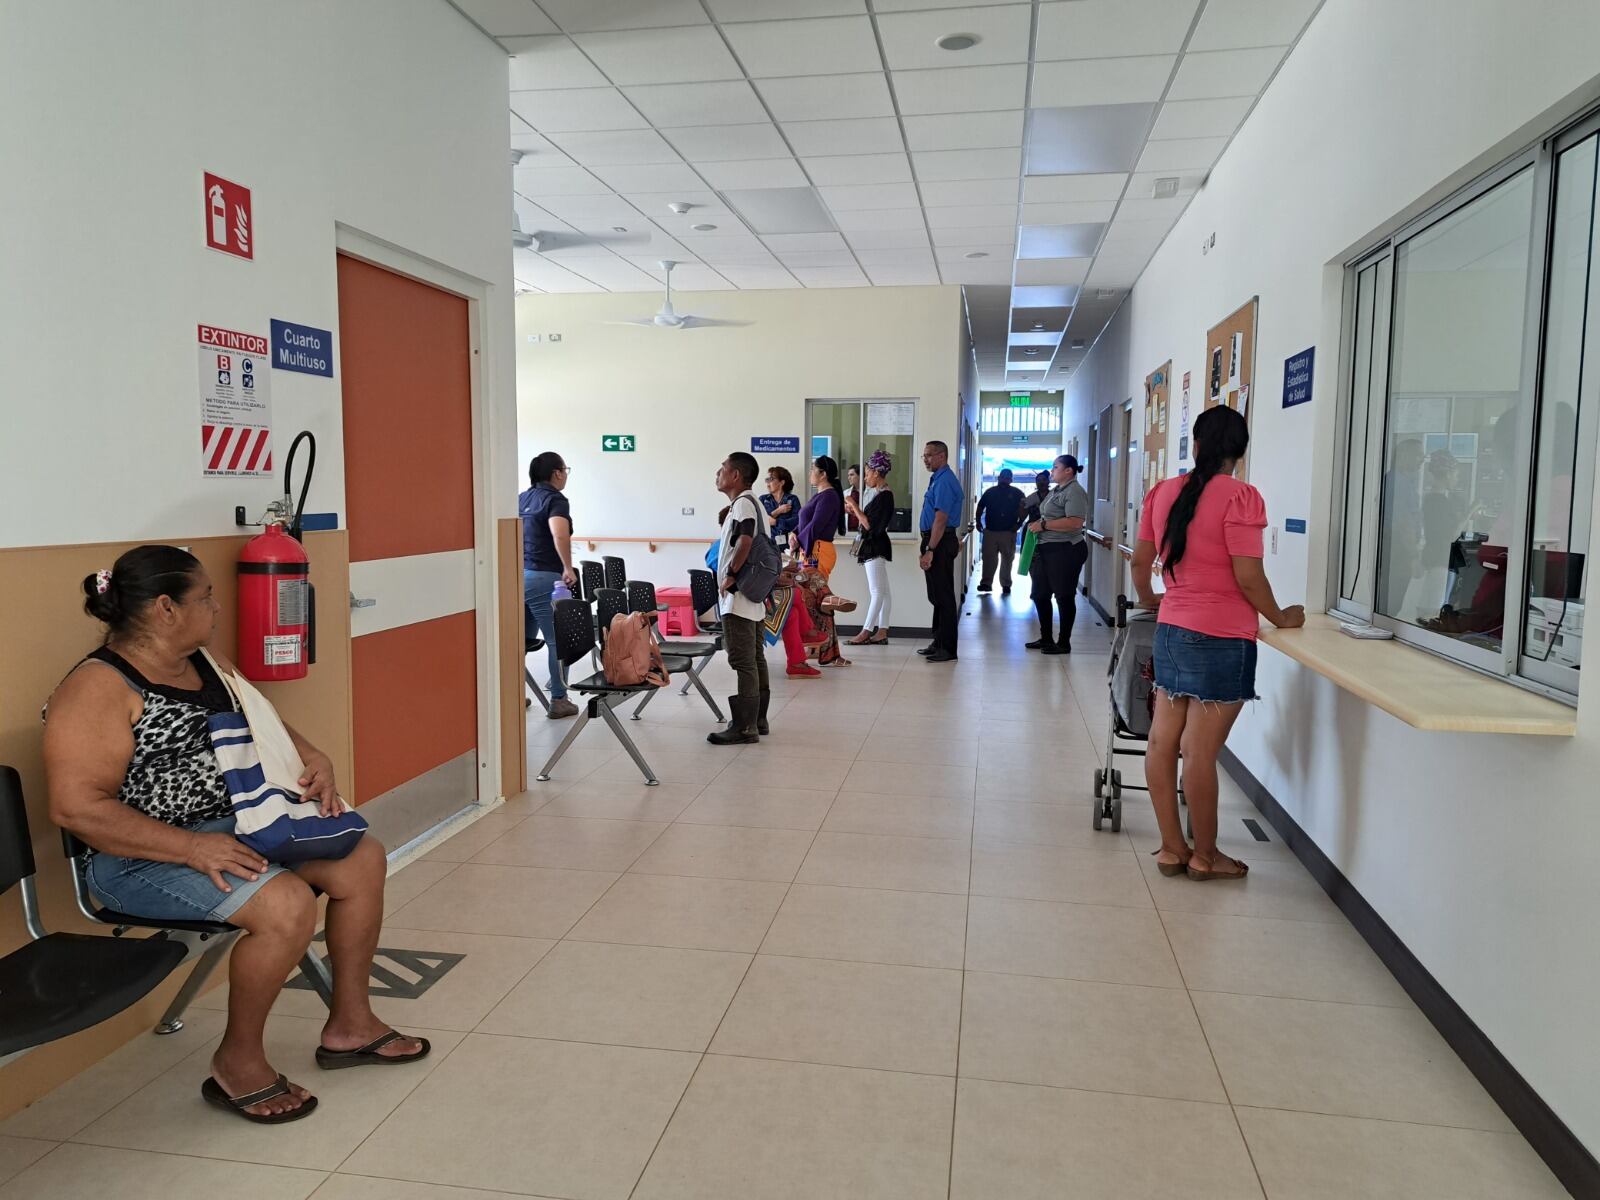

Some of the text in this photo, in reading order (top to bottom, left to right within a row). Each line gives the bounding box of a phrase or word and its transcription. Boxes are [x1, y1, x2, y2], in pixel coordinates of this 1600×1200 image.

[201, 327, 265, 353] EXTINTOR
[284, 328, 320, 350] Cuarto
[220, 356, 229, 370] B
[243, 359, 252, 372] C
[280, 347, 326, 371] Multiuso
[1289, 358, 1305, 373] Registro
[1294, 387, 1306, 401] Salud
[1011, 397, 1029, 406] SALIDA
